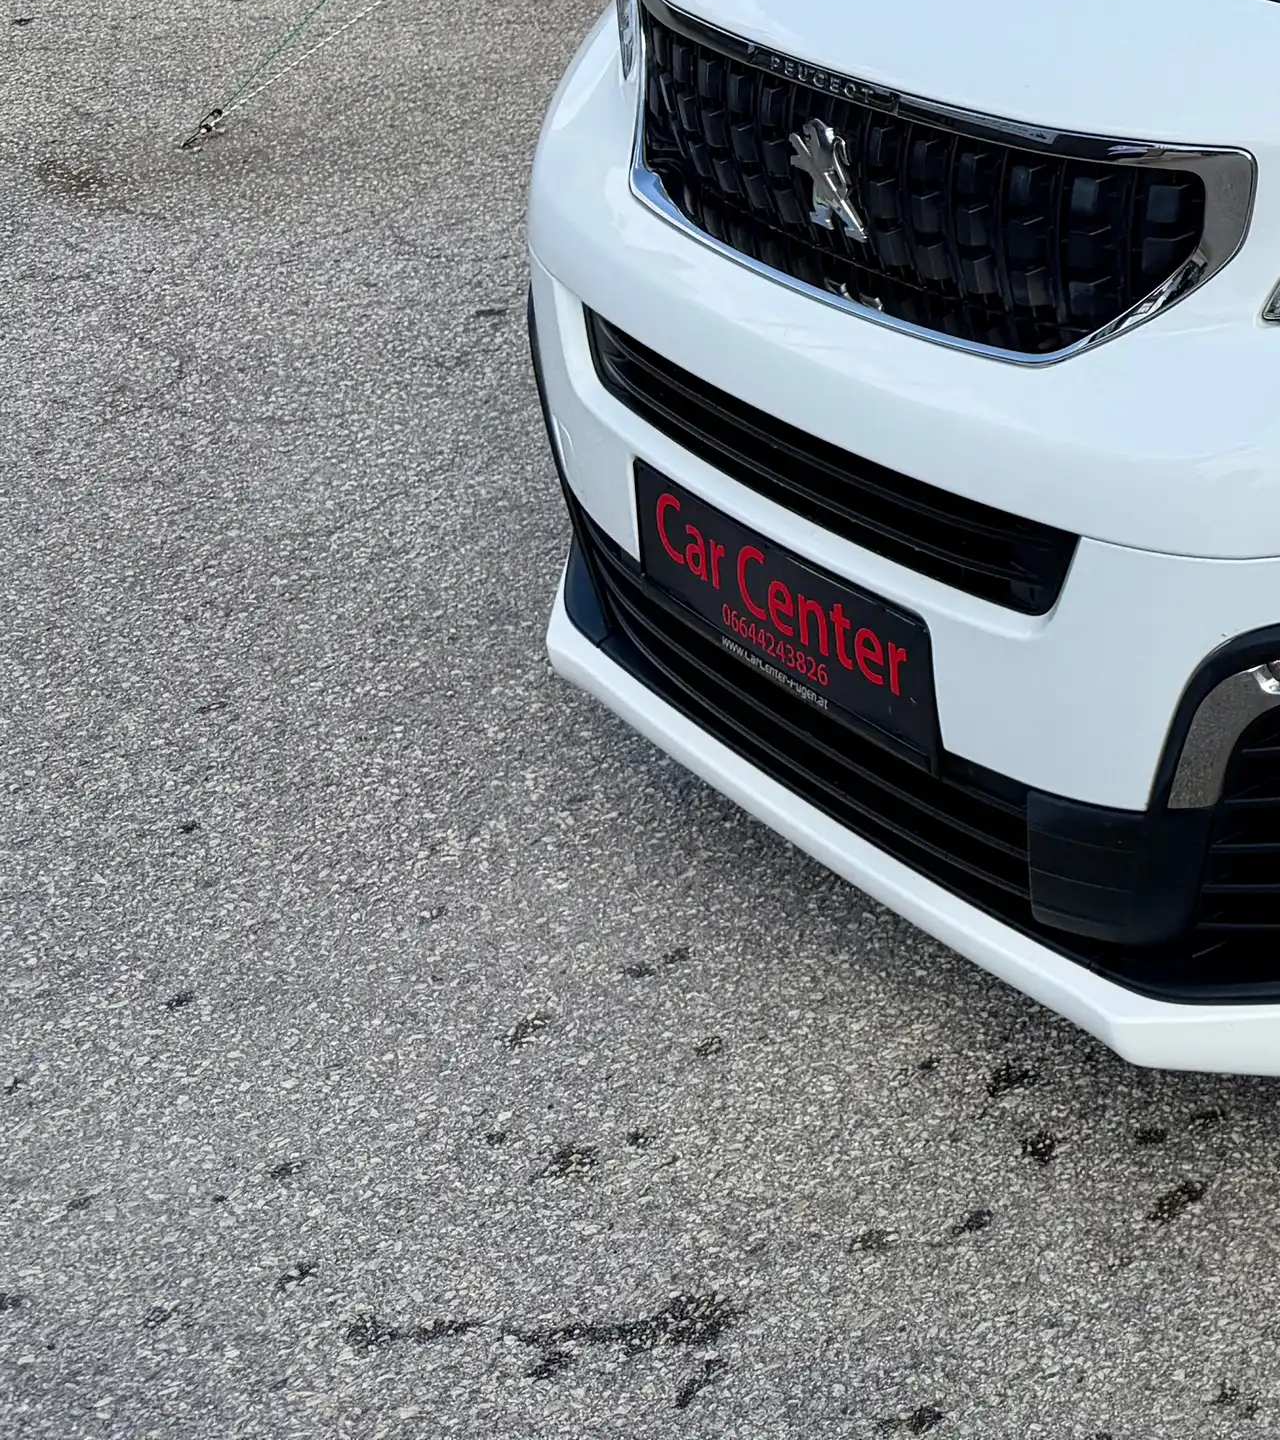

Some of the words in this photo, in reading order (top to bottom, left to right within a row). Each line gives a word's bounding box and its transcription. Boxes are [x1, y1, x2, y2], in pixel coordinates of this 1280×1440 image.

[770, 55, 874, 103] PEUGEOT
[656, 493, 725, 589] Car
[736, 545, 907, 696] Center
[722, 603, 828, 686] 06644243826
